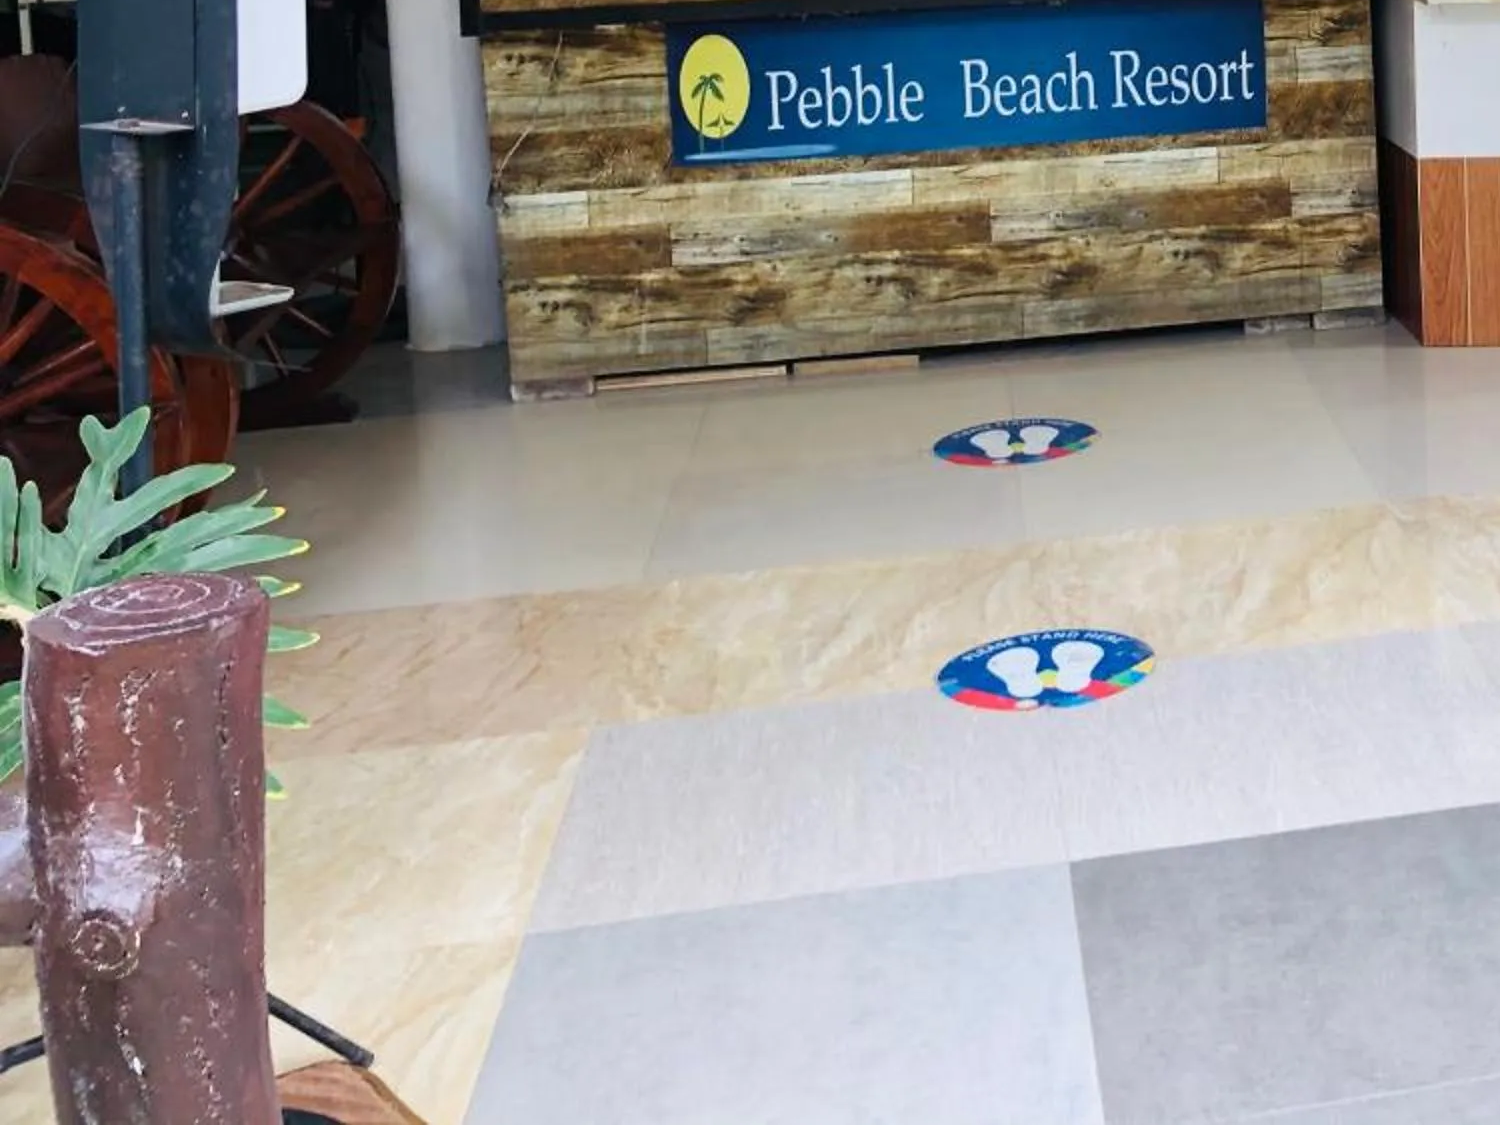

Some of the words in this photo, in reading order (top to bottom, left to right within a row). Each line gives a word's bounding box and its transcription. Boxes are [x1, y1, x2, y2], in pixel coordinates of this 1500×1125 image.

[765, 62, 925, 131] Pebble
[960, 51, 1098, 119] Beach
[1110, 49, 1256, 108] Resort
[1020, 631, 1080, 643] STAND
